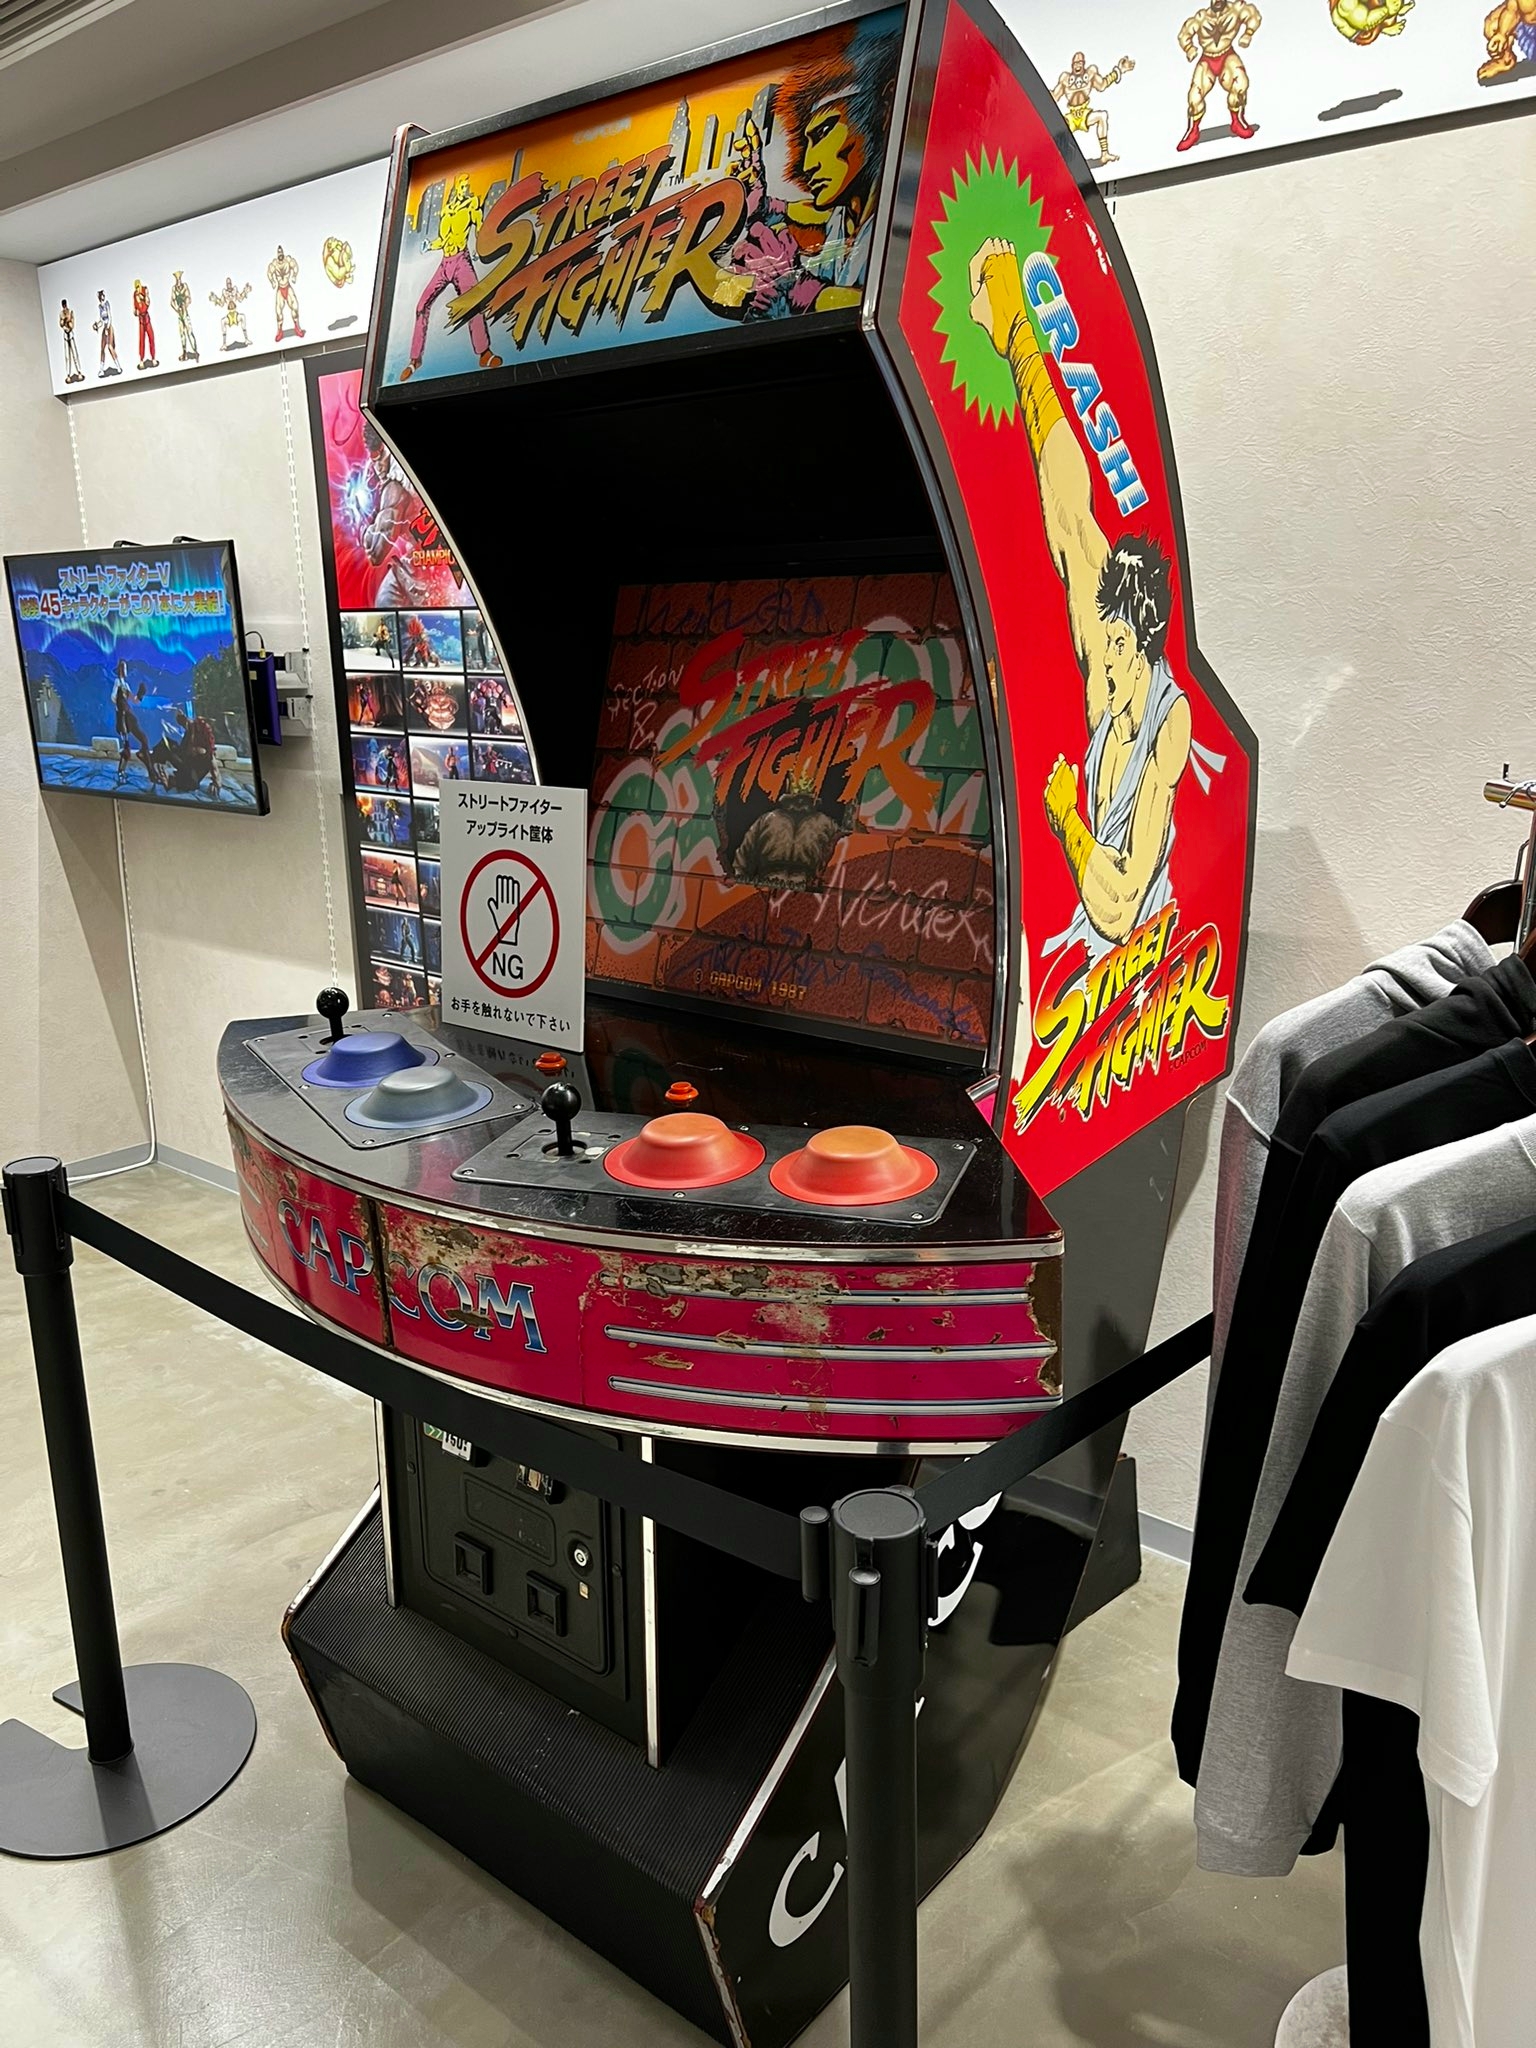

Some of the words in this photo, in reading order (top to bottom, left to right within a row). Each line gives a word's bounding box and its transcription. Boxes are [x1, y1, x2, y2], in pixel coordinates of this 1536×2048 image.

[446, 144, 675, 328] STREET
[482, 176, 754, 351] FIGHTER
[1022, 251, 1149, 517] CRASH
[413, 549, 456, 567] CHAMPIO
[653, 628, 869, 773] STREET
[695, 679, 943, 833] FIGHTER
[458, 793, 562, 815] ストリートファイター
[466, 820, 553, 843] アップライト筐体
[451, 997, 570, 1031] お手を触れないで下さい
[492, 952, 524, 980] NG
[710, 971, 761, 993] CAPCOM
[771, 980, 807, 1000] 1987
[1012, 899, 1179, 1135] STREET
[1047, 923, 1228, 1121] FIGHTER
[278, 1198, 547, 1352] CAPCOM
